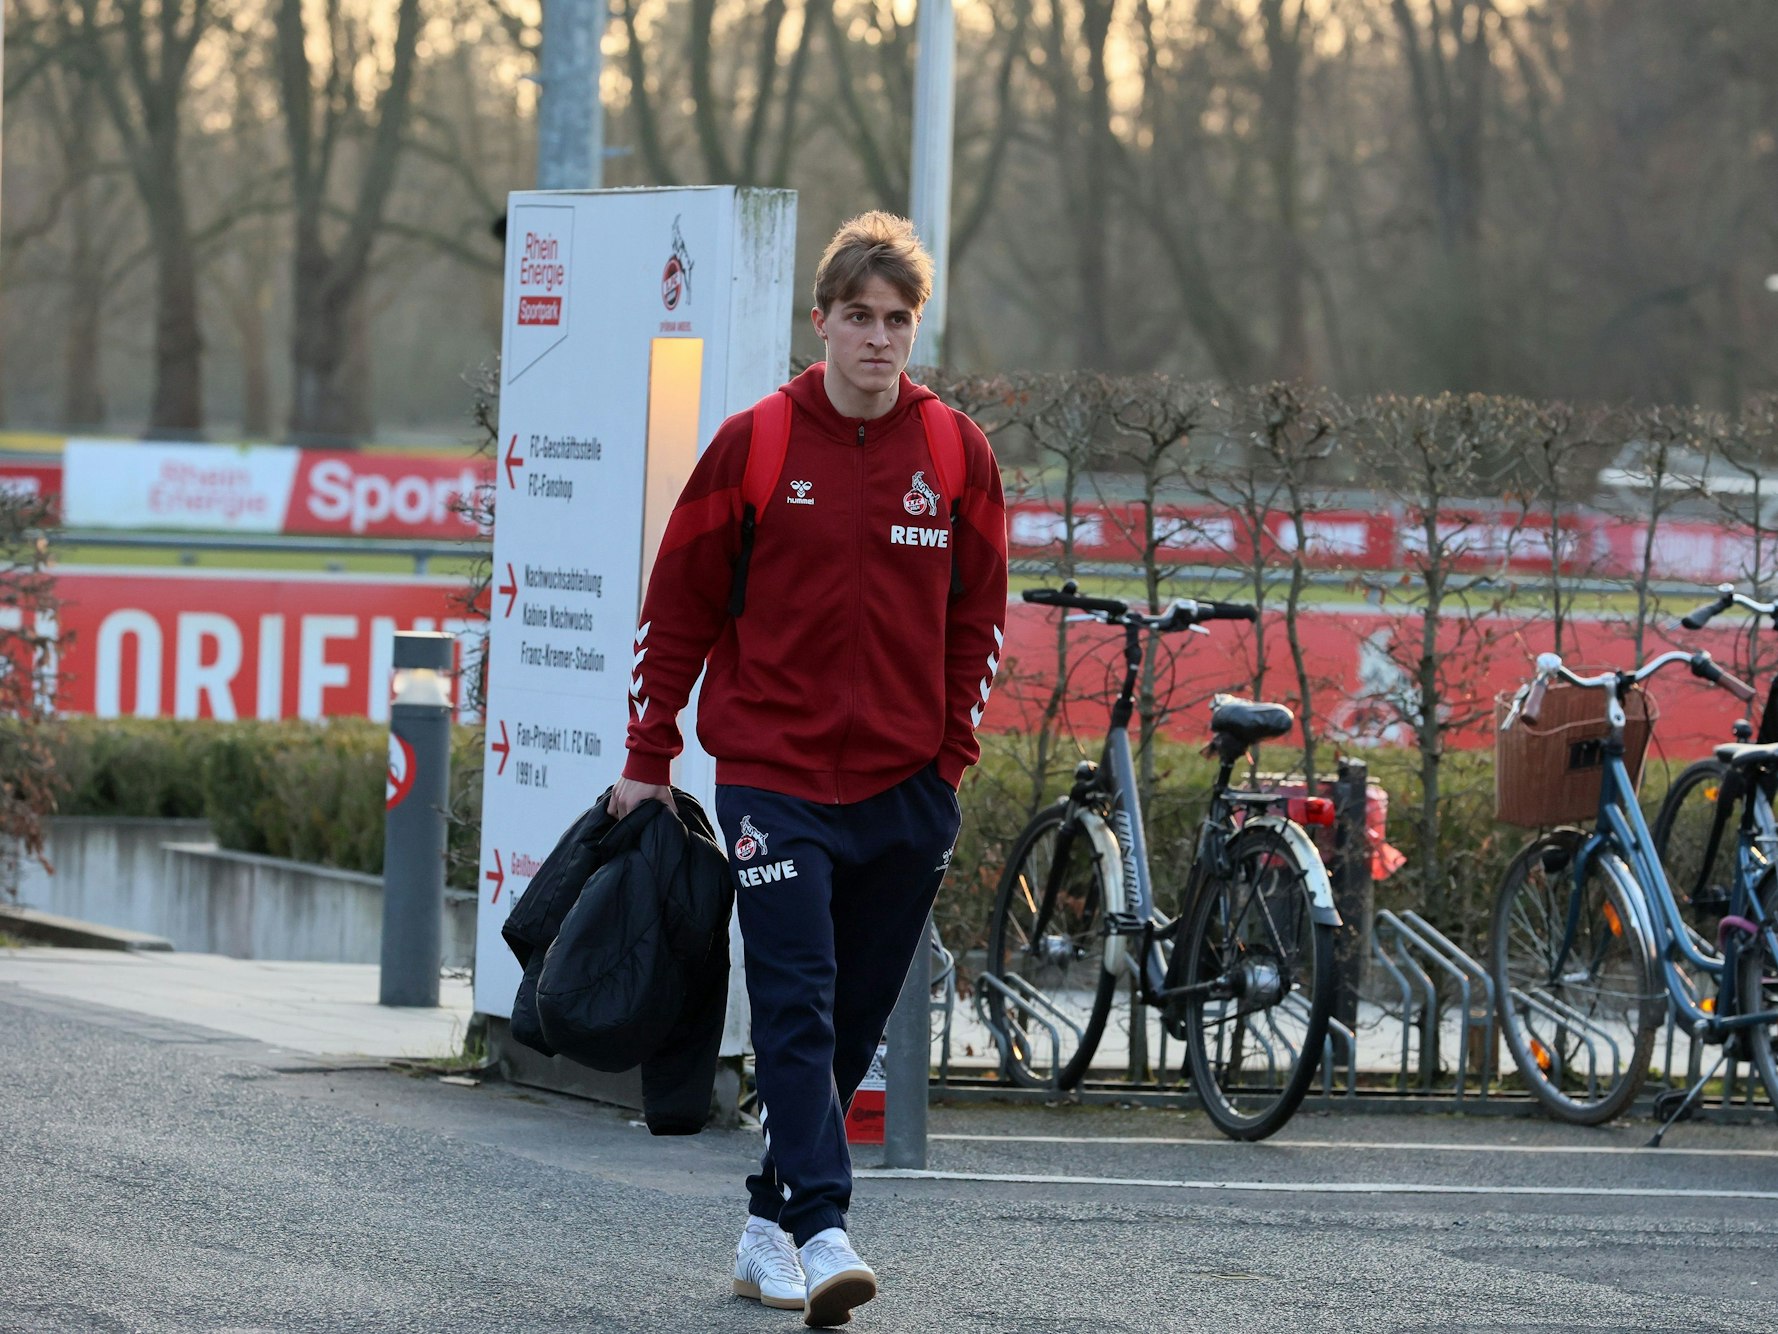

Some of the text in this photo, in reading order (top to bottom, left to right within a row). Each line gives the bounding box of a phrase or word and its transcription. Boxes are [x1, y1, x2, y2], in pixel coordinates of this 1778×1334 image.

[526, 232, 558, 260] Rhein
[520, 258, 564, 291] Energie
[520, 300, 559, 323] Sportpark
[528, 472, 573, 502] FC-Fanshop
[787, 496, 815, 506] hummel
[890, 524, 949, 549] REWE
[524, 564, 603, 598] Nachwuchsabteilung
[522, 602, 593, 632] Kabine Nachwuchs
[520, 640, 605, 672] Franz-Kremer-Stadion
[517, 721, 602, 758] Fan-Projekt 1. FC Köln
[515, 761, 533, 786] 1991
[738, 859, 799, 889] REWE
